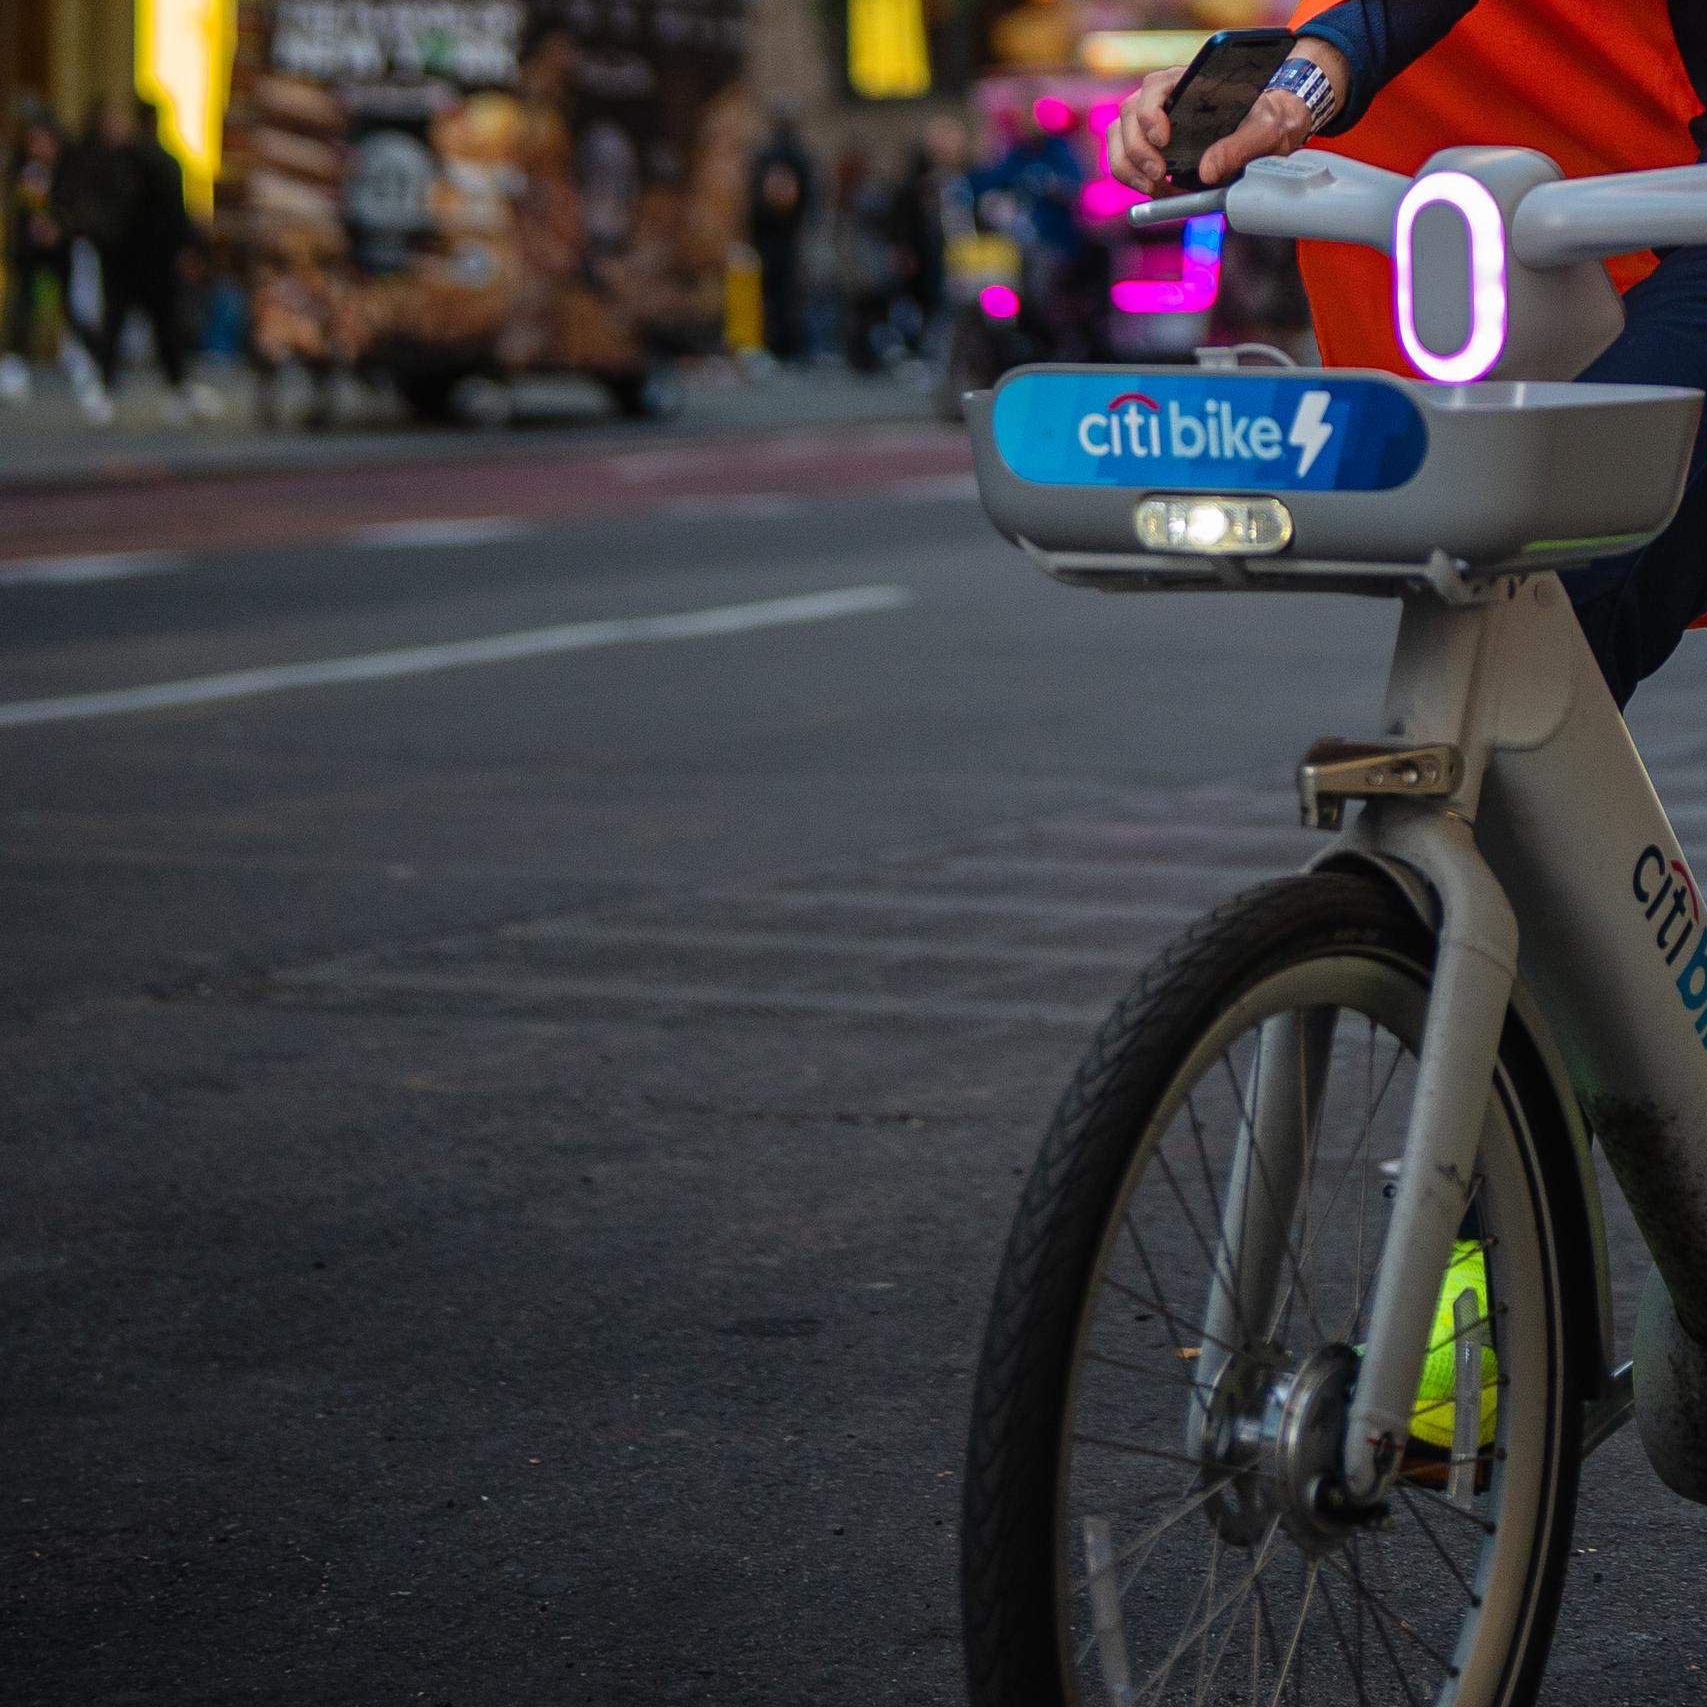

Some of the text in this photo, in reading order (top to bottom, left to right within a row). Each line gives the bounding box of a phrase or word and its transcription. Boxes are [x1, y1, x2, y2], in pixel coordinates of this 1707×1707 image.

[1078, 393, 1283, 460] citi bike
[1633, 844, 1698, 966] citi
